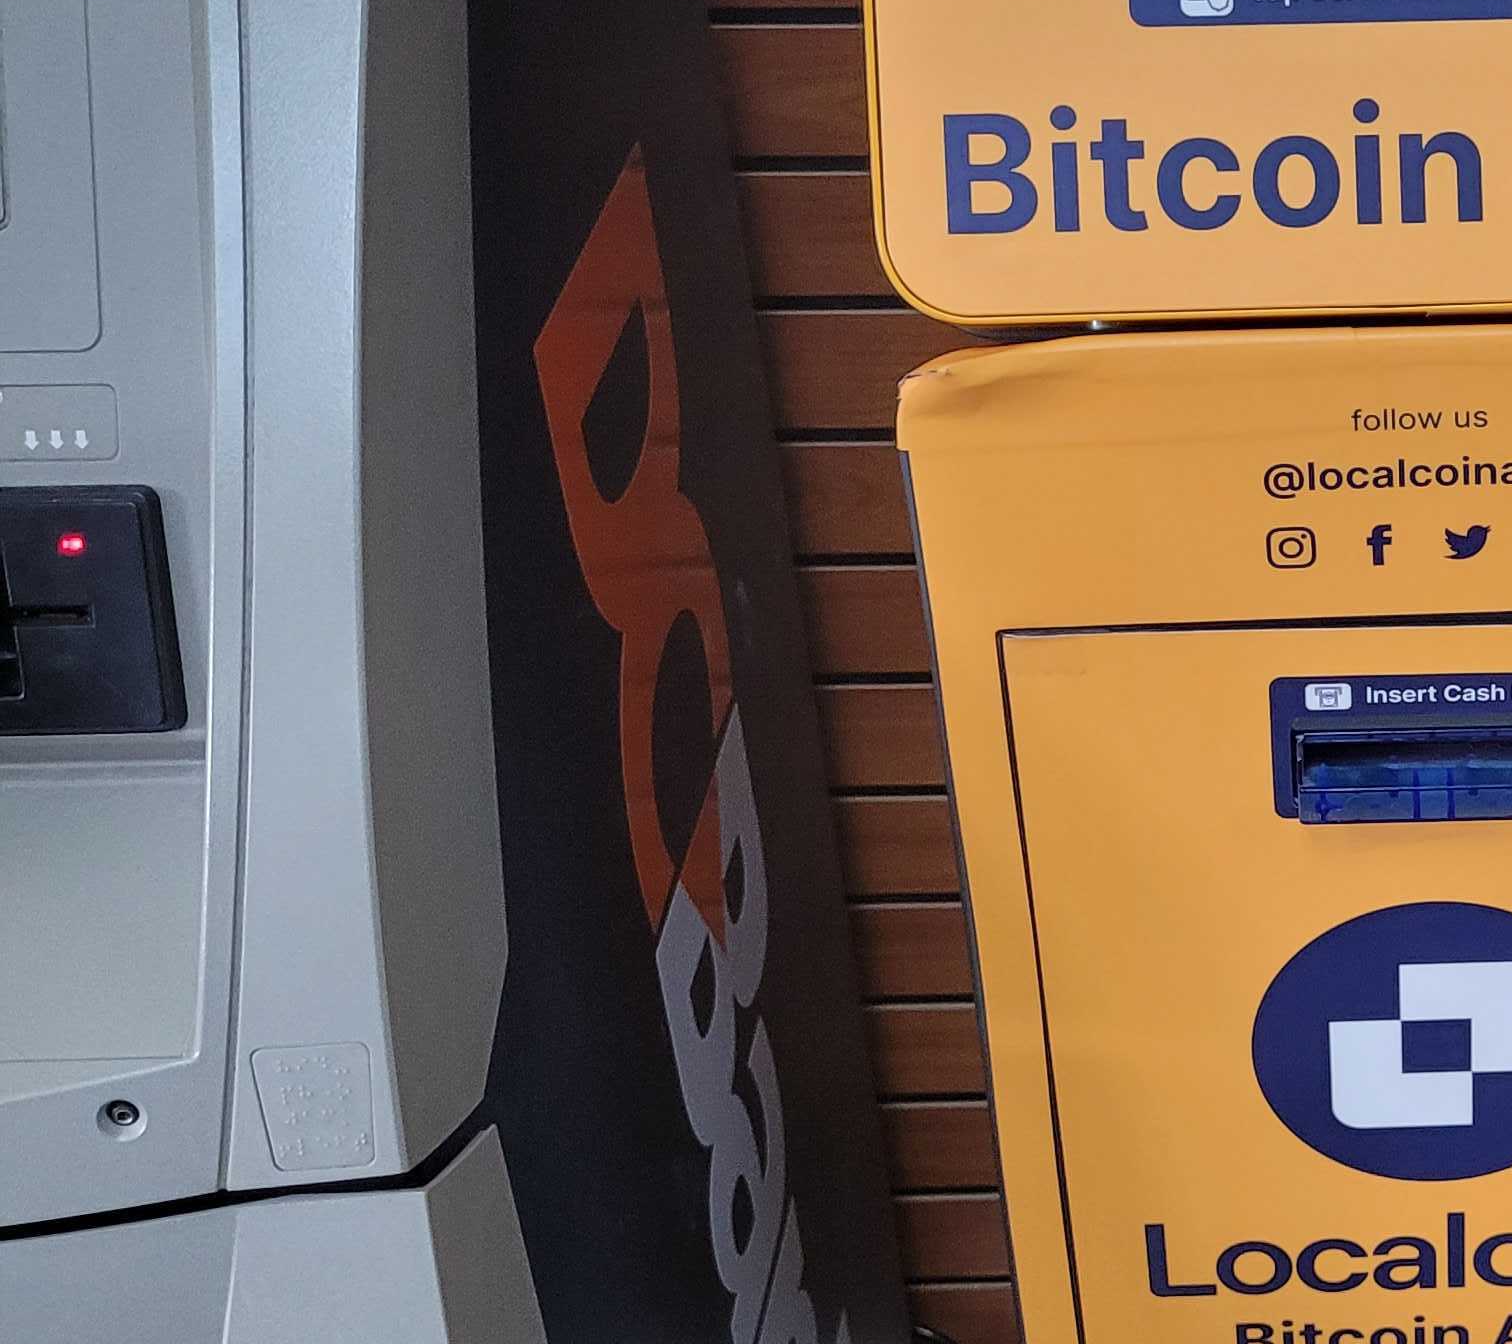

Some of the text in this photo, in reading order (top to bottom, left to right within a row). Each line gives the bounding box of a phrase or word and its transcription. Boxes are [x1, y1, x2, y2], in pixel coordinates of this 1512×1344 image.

[943, 97, 1483, 233] Bitcoin
[1351, 407, 1489, 433] follow us
[1366, 685, 1437, 705] Insert
[1444, 683, 1506, 703] Cash
